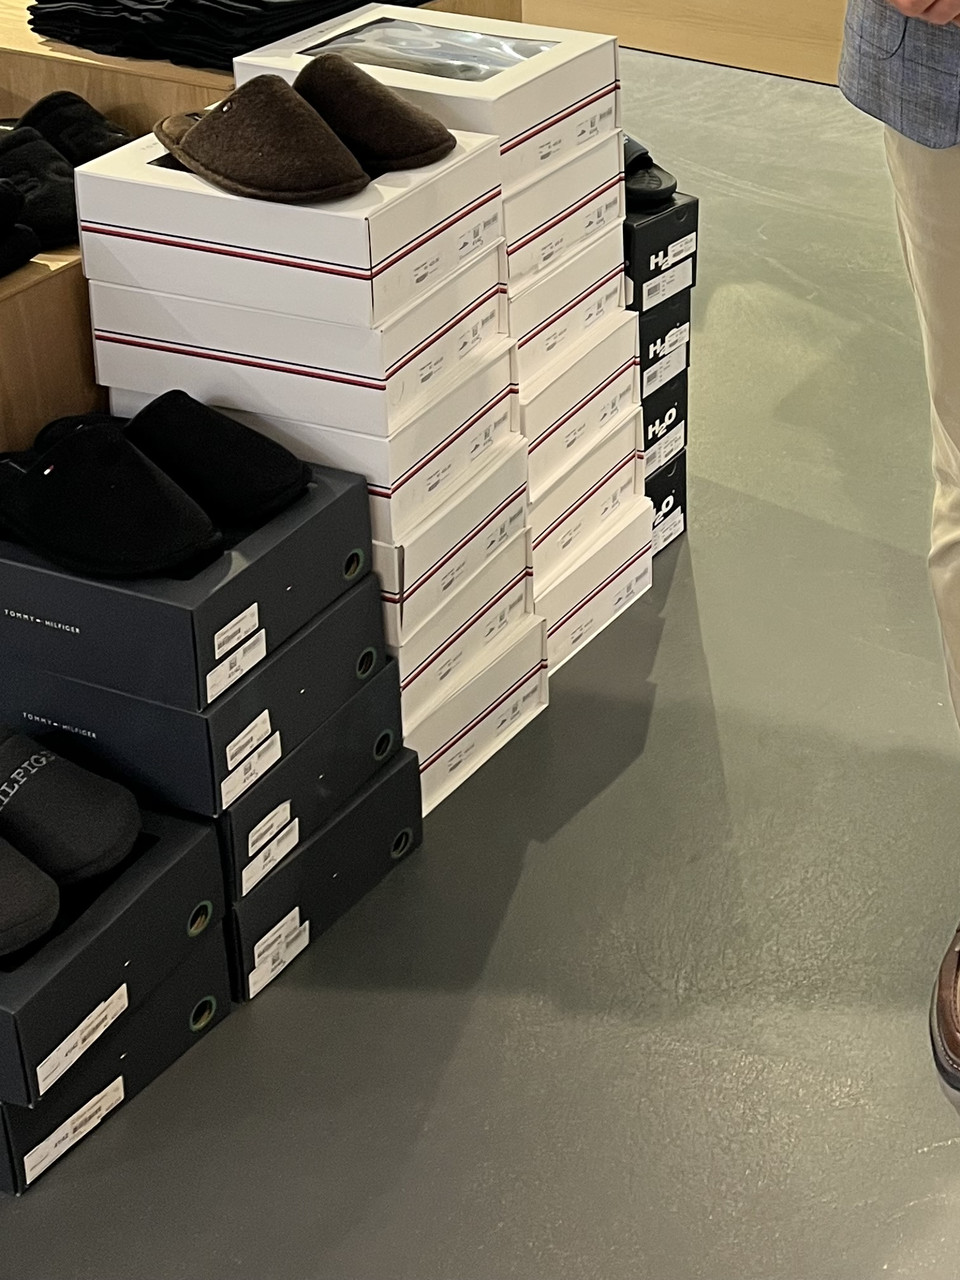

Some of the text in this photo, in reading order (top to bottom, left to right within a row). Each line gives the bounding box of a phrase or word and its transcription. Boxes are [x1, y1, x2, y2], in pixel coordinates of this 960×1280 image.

[4, 609, 80, 634] TOMMY HILFIGER
[23, 712, 97, 739] TOMMY HILFIGER
